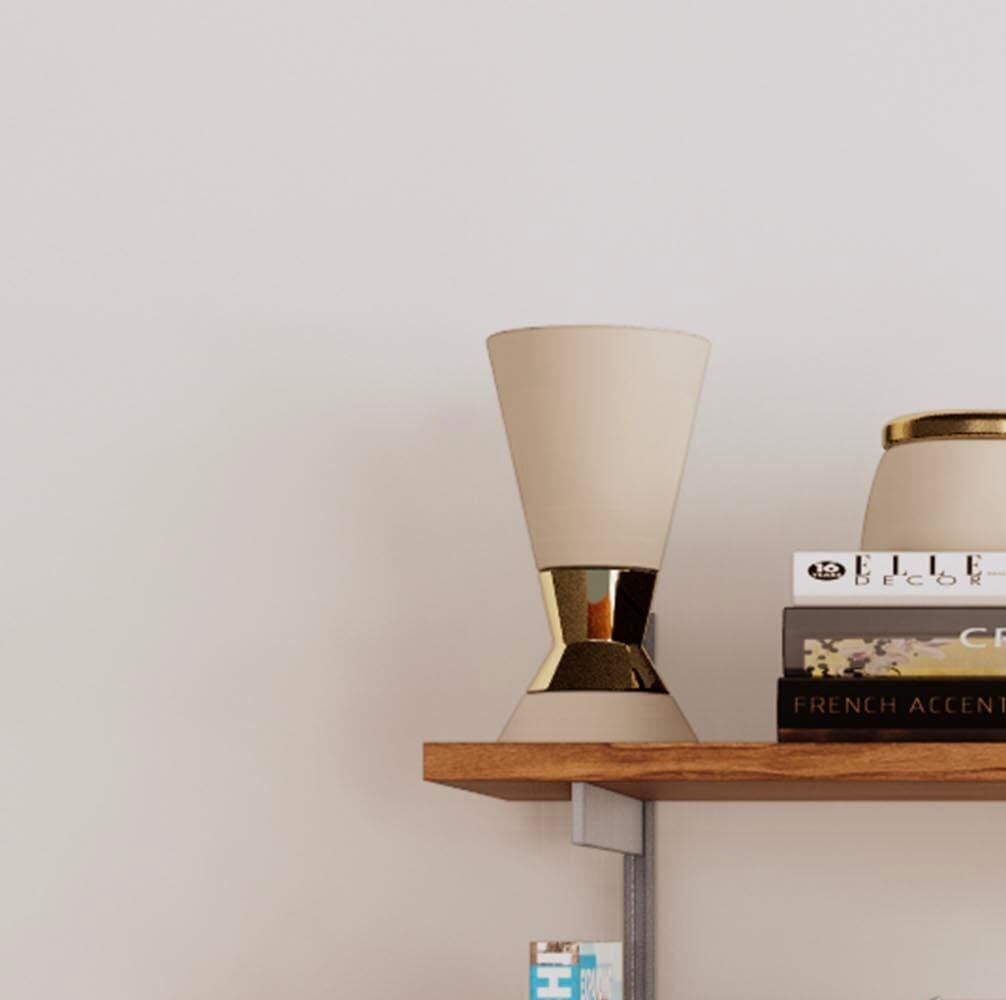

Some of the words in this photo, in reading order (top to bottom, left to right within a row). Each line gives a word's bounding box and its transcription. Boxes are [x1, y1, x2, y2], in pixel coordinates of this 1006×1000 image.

[855, 554, 983, 576] ELLE
[854, 575, 983, 586] DECOR
[793, 696, 896, 714] FRENCH
